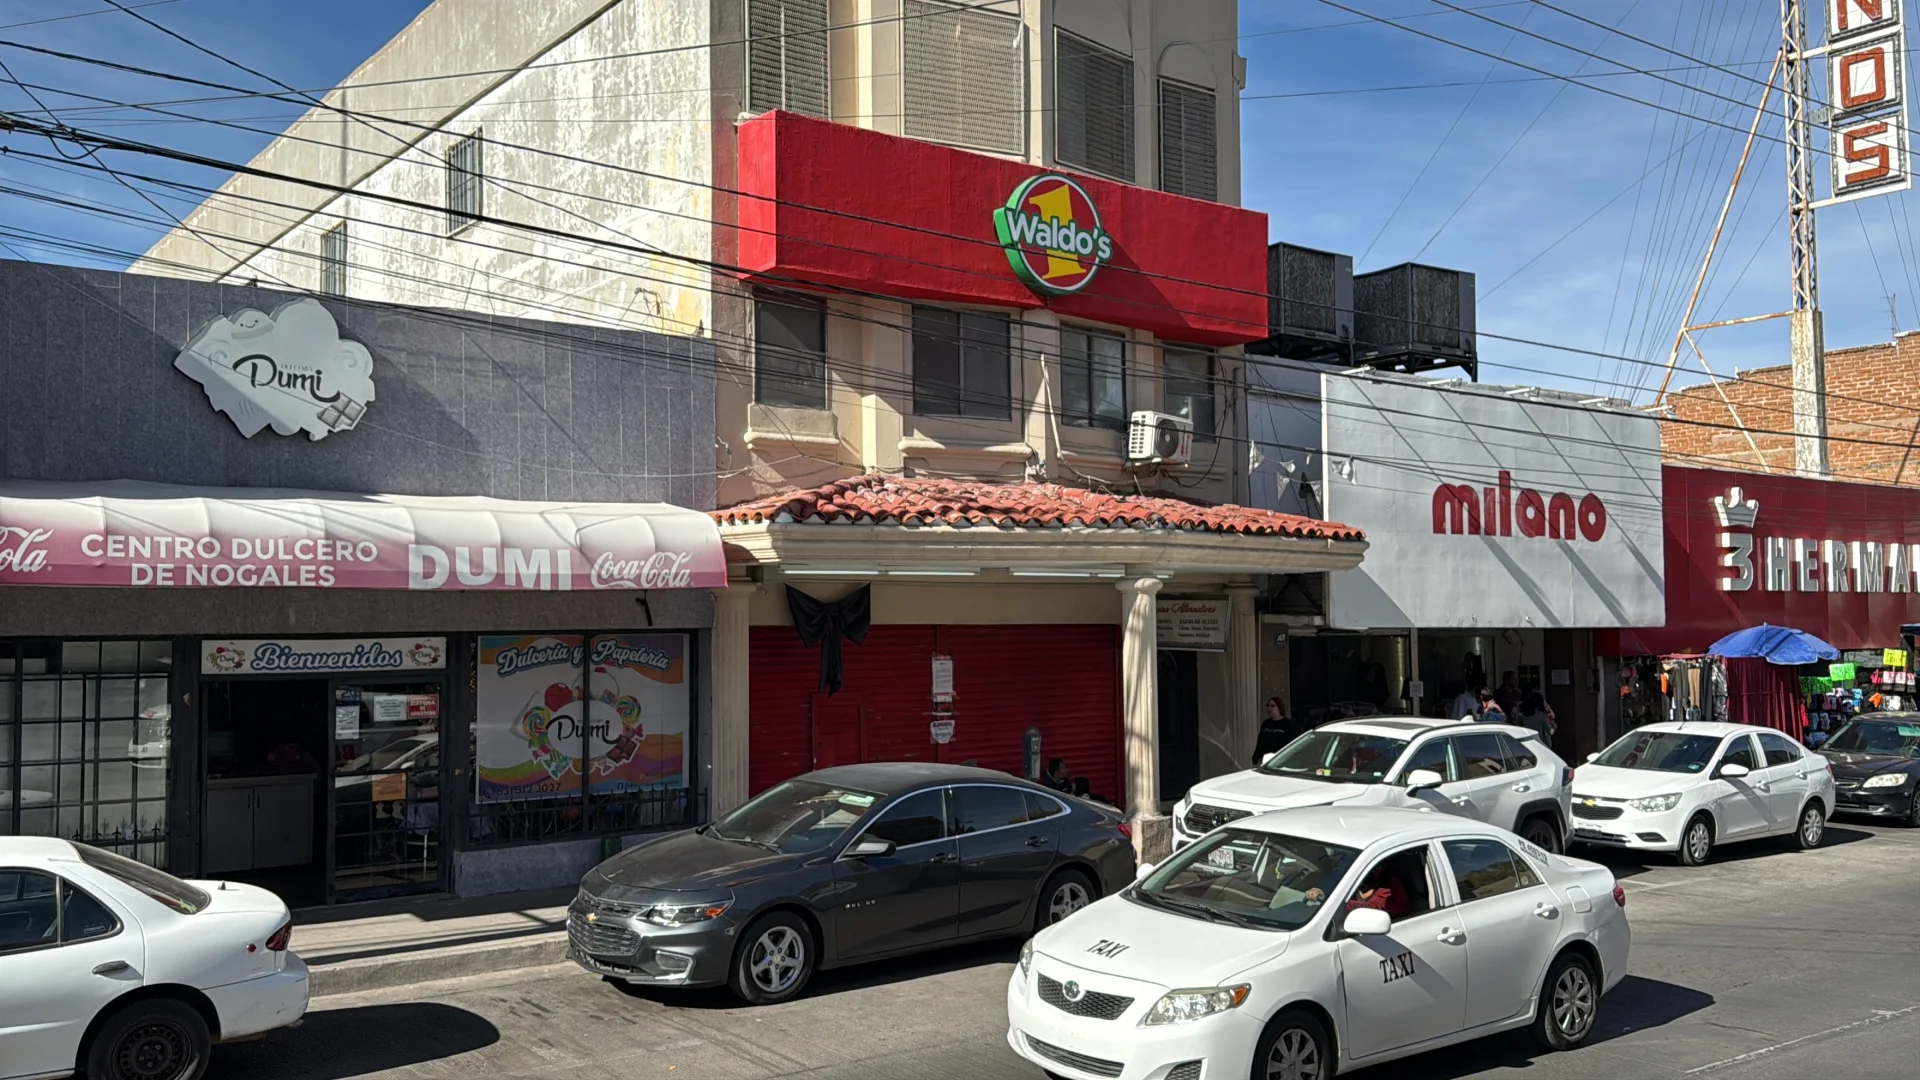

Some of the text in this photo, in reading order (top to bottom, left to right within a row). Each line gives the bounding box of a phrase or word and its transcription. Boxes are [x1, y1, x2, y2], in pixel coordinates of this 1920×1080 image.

[1005, 208, 1112, 260] Waldo's
[232, 354, 341, 403] Dumi
[1432, 470, 1607, 542] milano
[80, 533, 379, 563] CENTRO DULCERO
[1716, 532, 1920, 593] 3 HERMA
[131, 563, 336, 588] DE NOGALES
[408, 544, 573, 591] DUMI
[590, 551, 693, 588] Coca-Cola
[251, 642, 403, 671] Bienvenidos
[571, 643, 584, 667] y
[545, 714, 623, 744] Dumi
[536, 782, 562, 793] 3027
[1084, 939, 1131, 960] TAXI
[1378, 951, 1417, 984] TAXI
